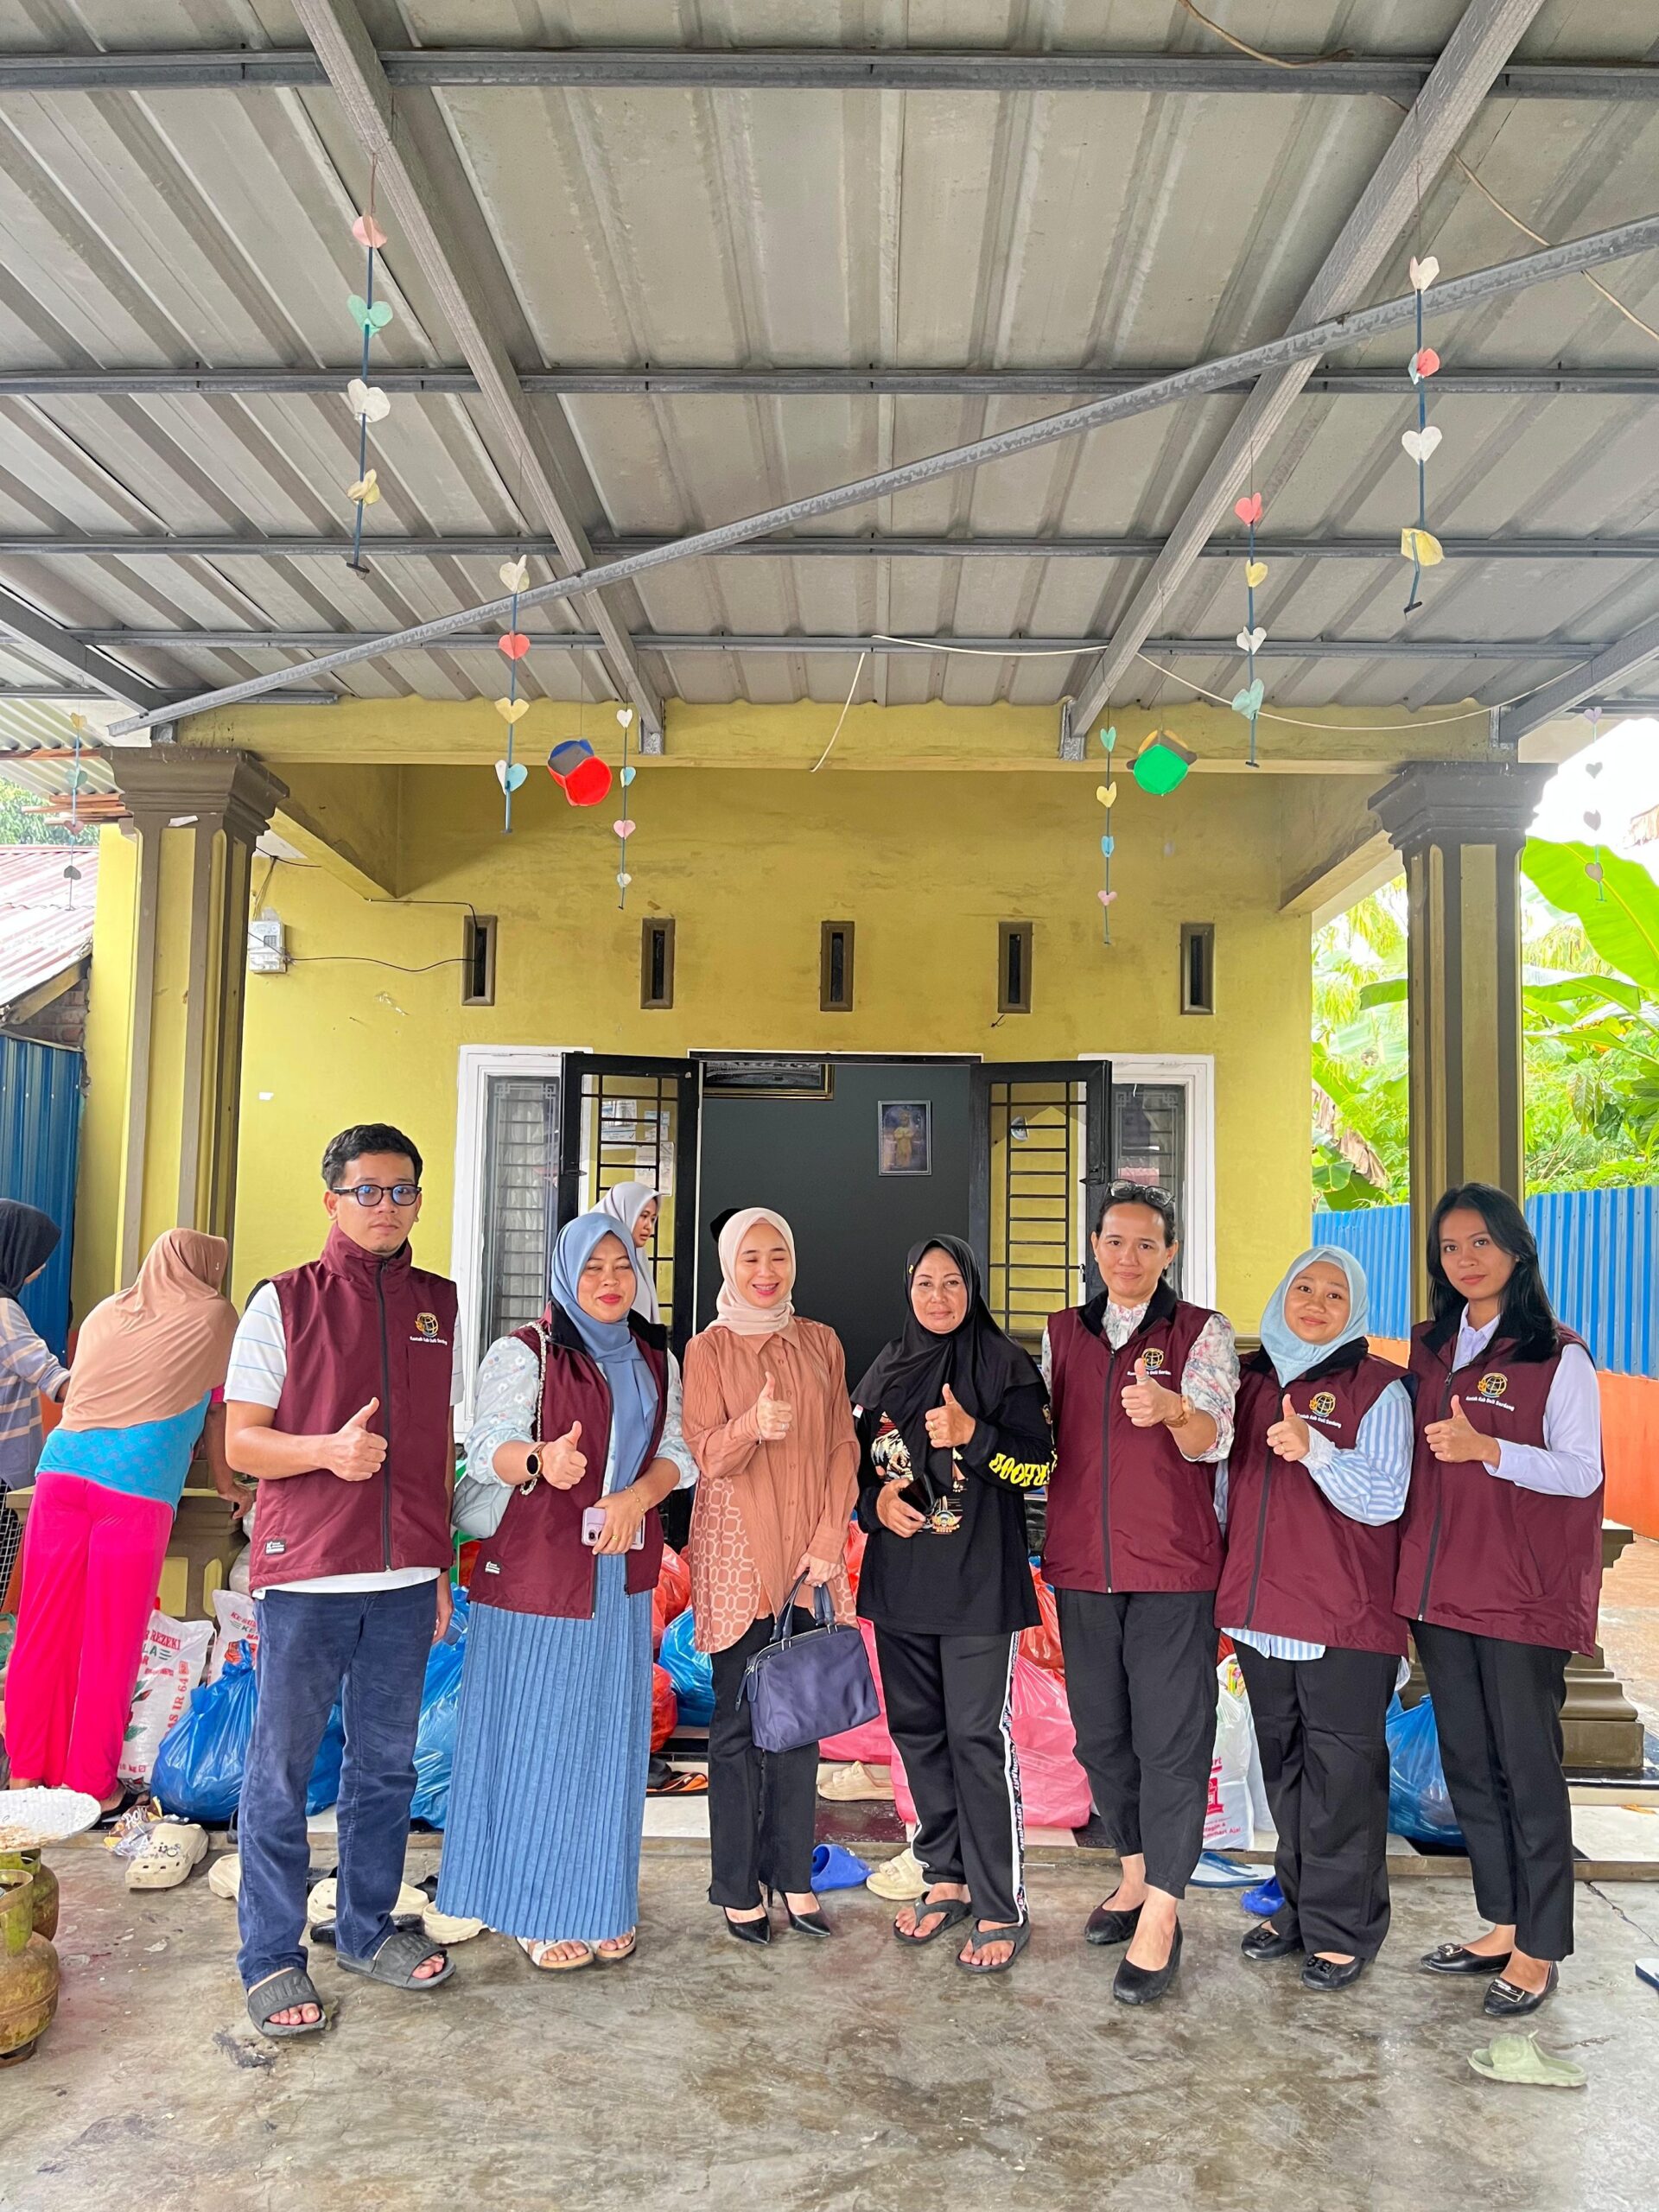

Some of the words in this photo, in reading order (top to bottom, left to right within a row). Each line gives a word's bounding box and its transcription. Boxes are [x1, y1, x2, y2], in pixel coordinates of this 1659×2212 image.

[1495, 1400, 1515, 1412] Serdang
[149, 1629, 181, 1650] REZEKI
[178, 1678, 188, 1692] 64
[172, 1696, 185, 1711] IR
